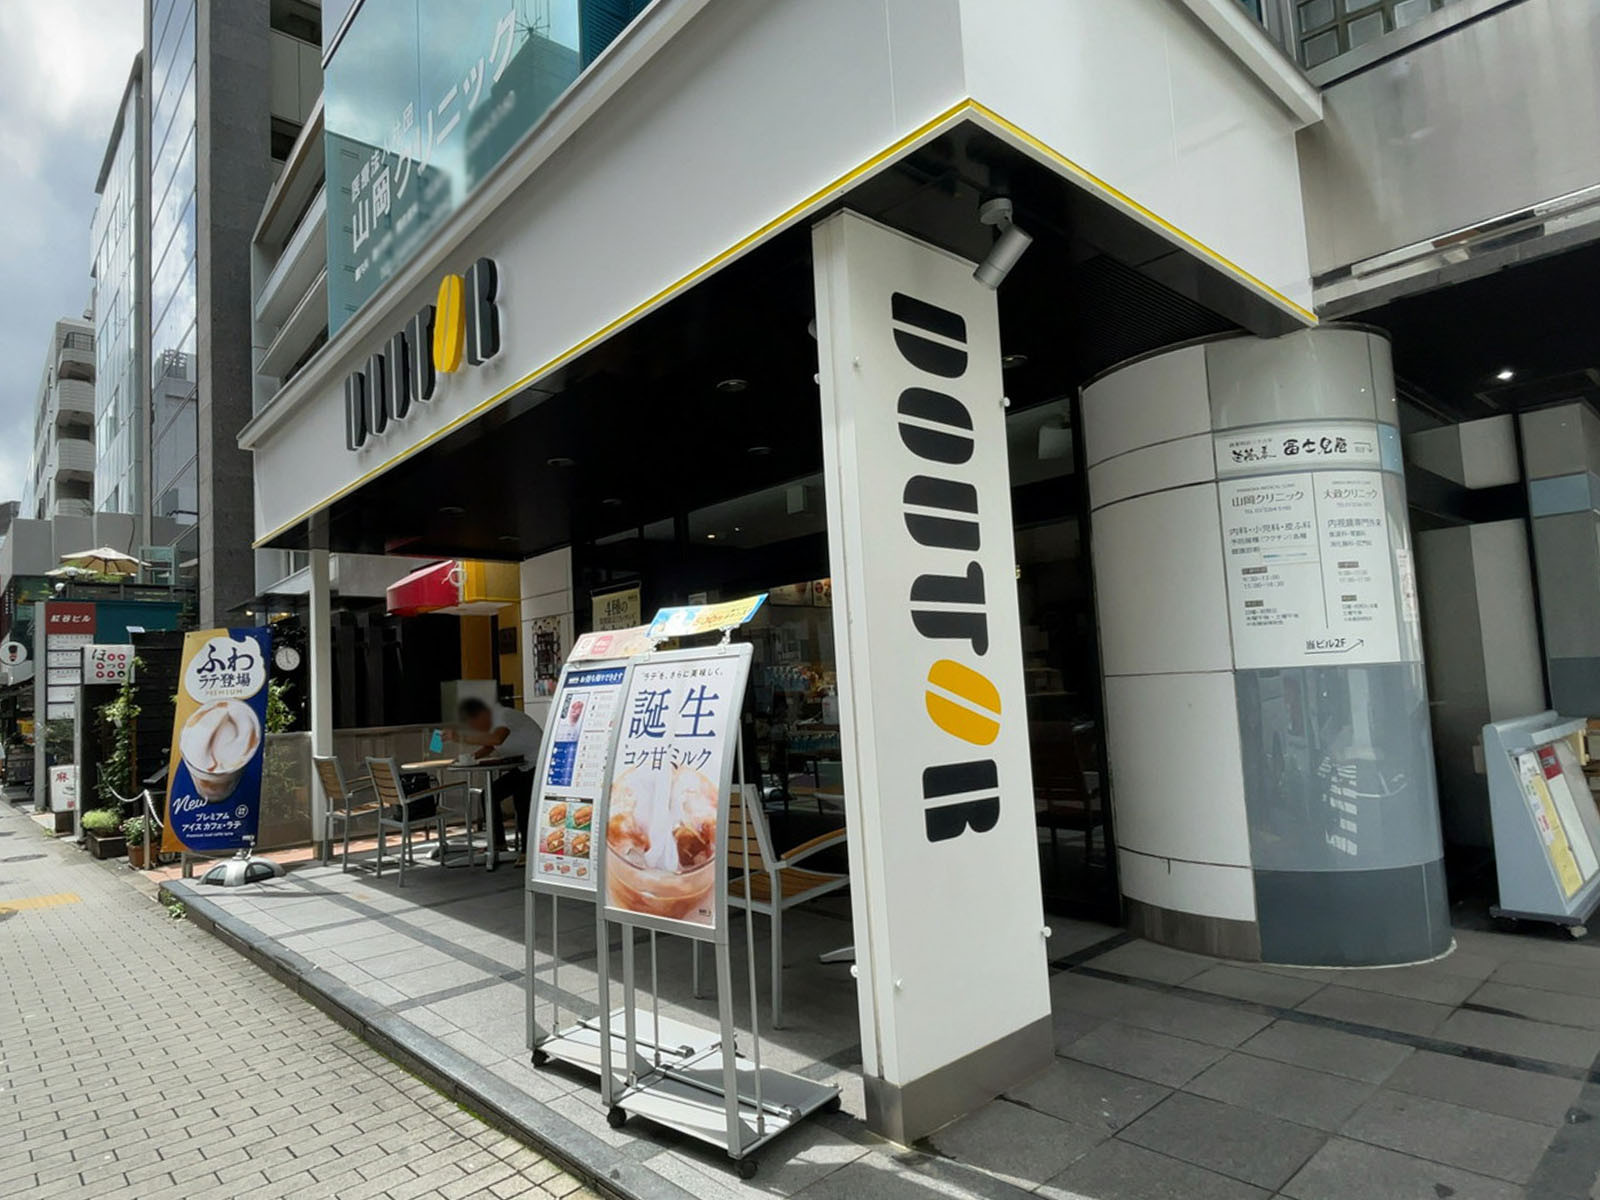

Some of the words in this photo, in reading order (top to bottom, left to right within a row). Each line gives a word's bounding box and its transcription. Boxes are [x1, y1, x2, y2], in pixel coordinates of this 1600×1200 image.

[353, 8, 517, 253] 山岡クリニック
[344, 256, 501, 452] DOUTOR
[891, 290, 1003, 843] DOUTOR
[196, 643, 255, 675] ふわ
[198, 672, 251, 690] ラテ登場
[628, 684, 720, 739] 誕生
[172, 794, 208, 815] New
[195, 812, 230, 822] プレミアム
